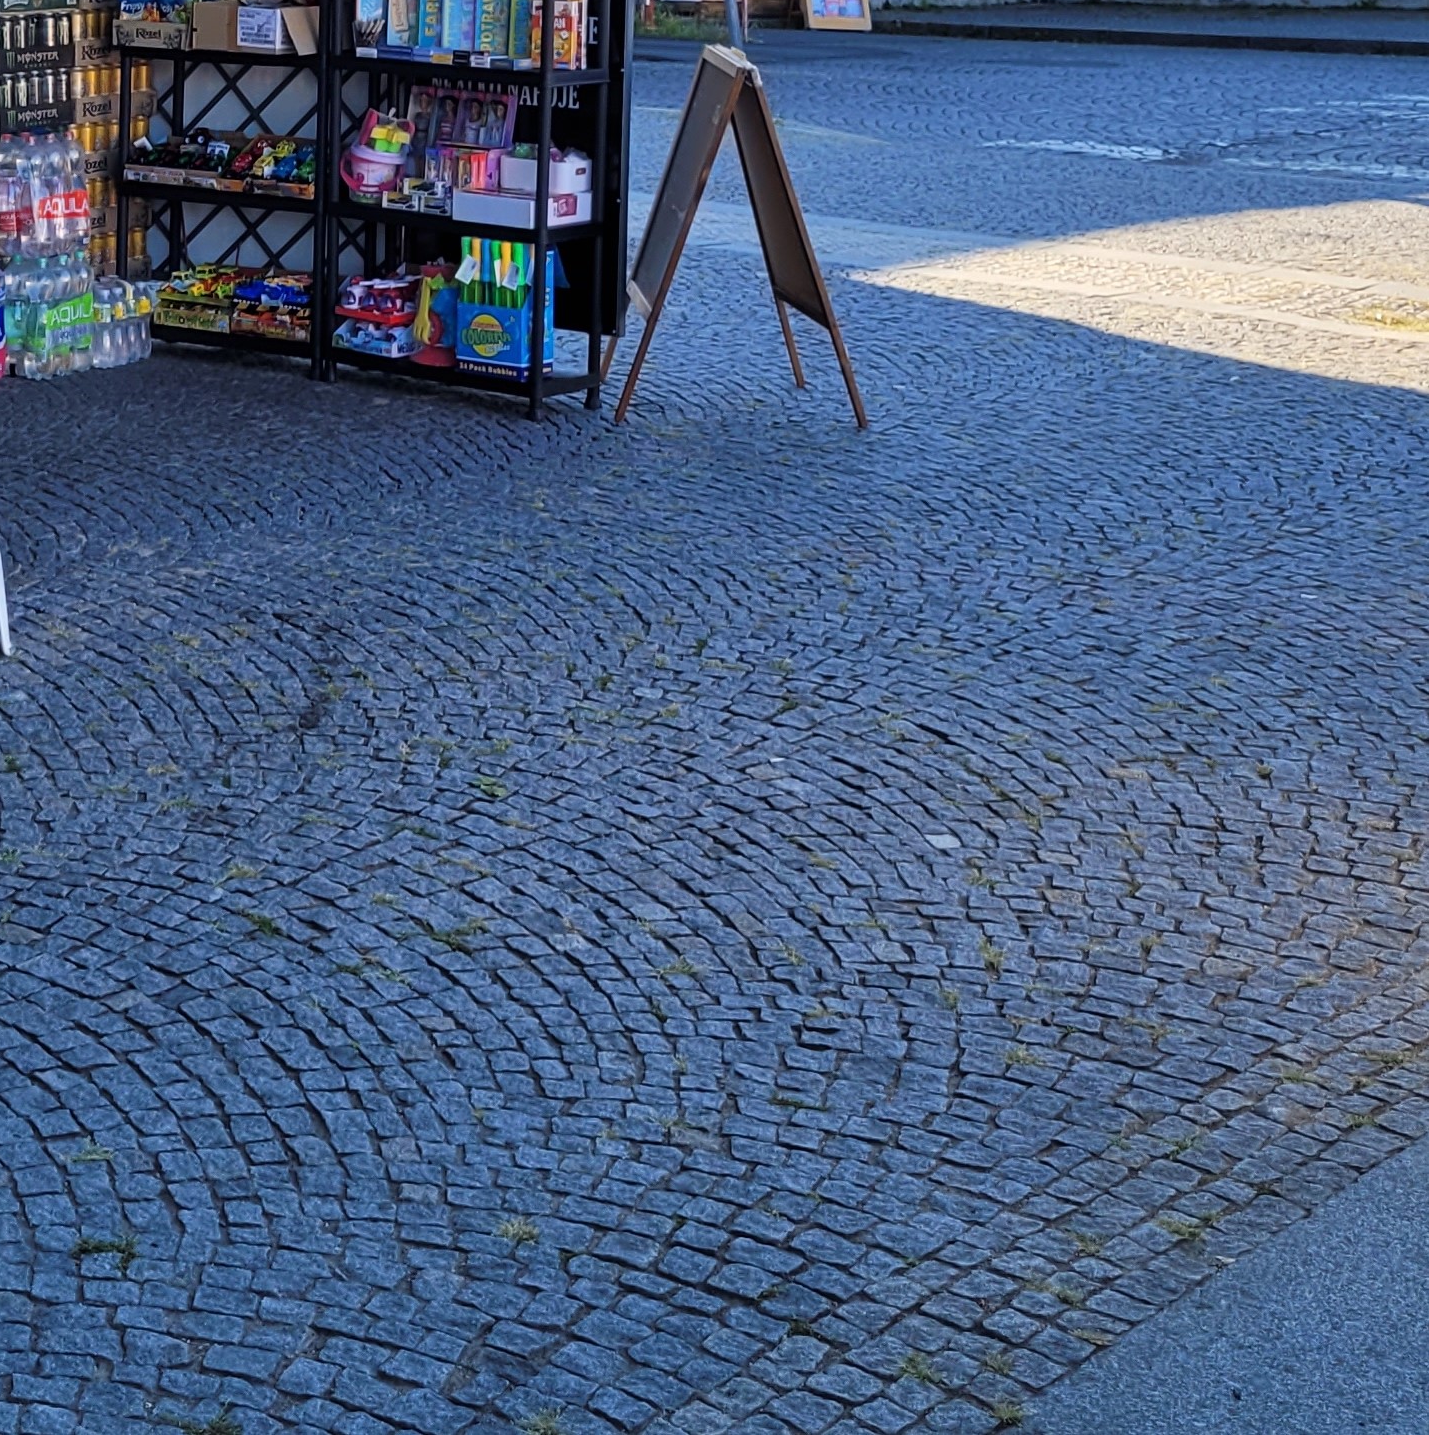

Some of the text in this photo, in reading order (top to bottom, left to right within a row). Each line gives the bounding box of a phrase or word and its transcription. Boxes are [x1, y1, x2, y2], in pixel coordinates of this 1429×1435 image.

[17, 50, 59, 63] MONSTER
[81, 44, 112, 60] Kozel
[17, 107, 59, 120] MONSTER
[82, 100, 112, 117] Kozel
[43, 195, 90, 215] AQUILA
[468, 363, 487, 373] Pack
[487, 366, 518, 377] Bubbles
